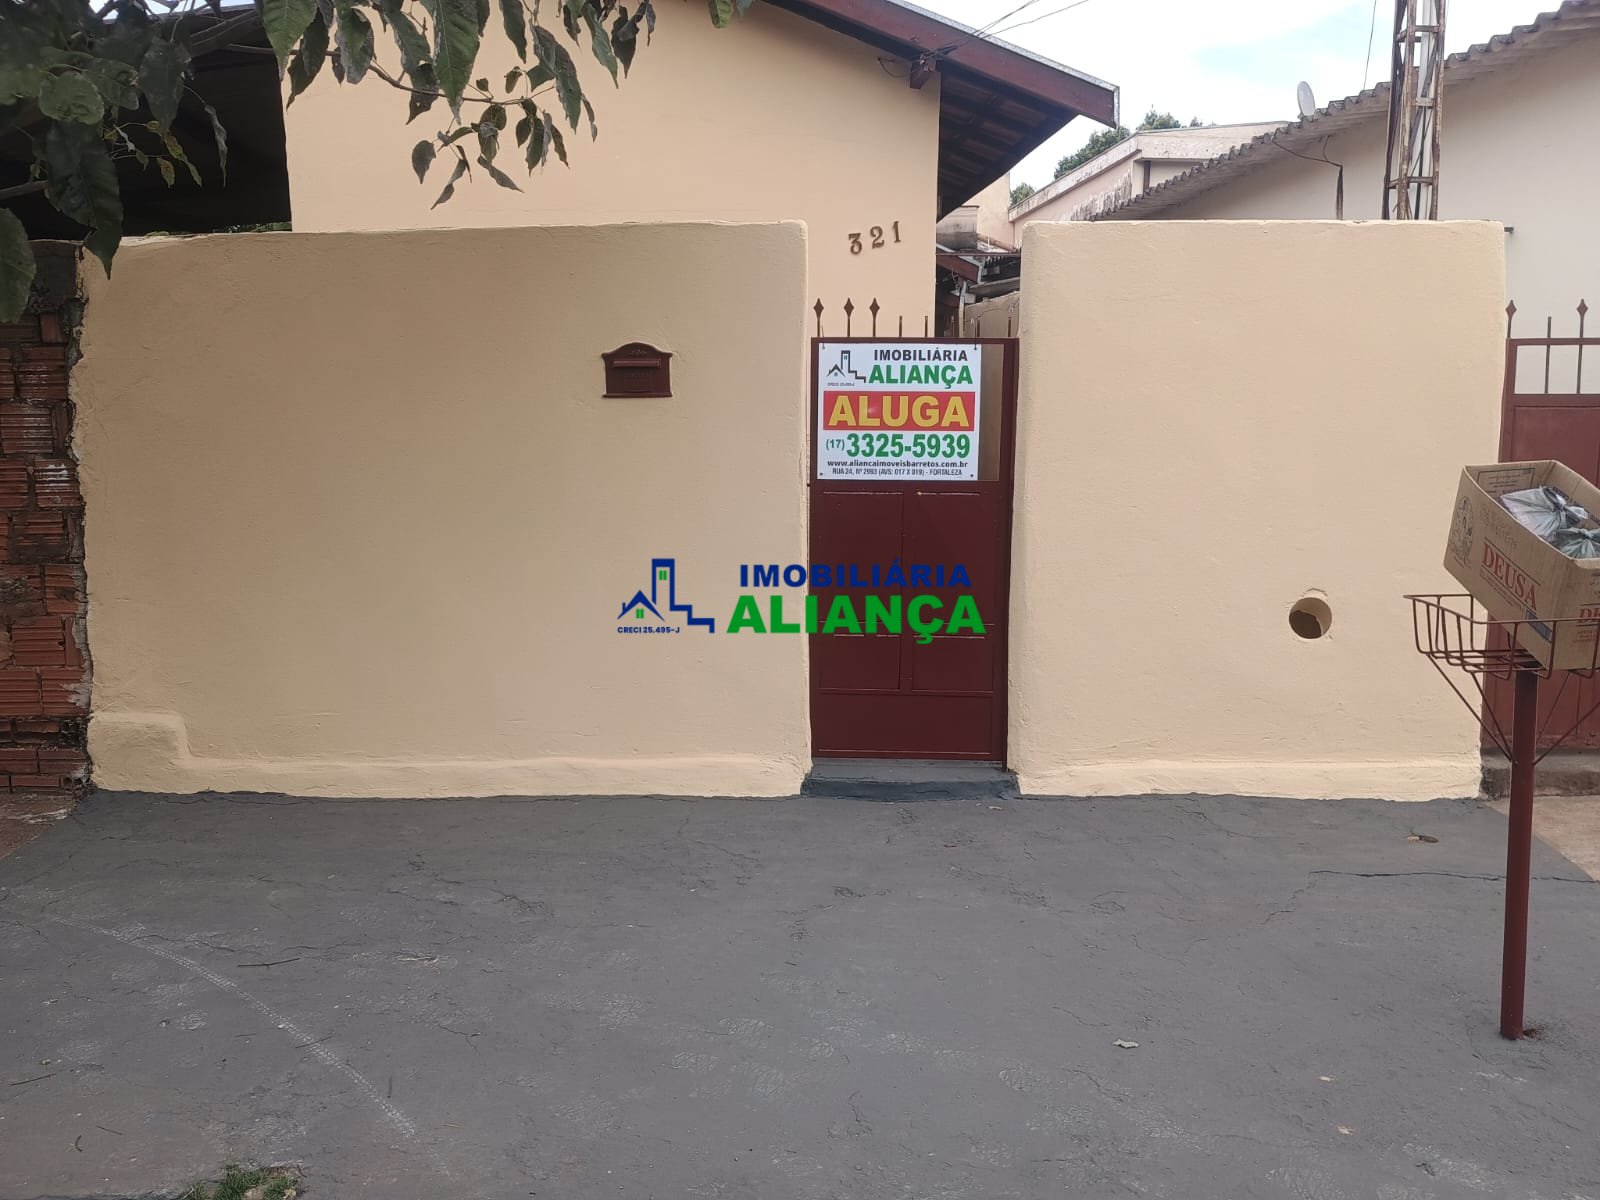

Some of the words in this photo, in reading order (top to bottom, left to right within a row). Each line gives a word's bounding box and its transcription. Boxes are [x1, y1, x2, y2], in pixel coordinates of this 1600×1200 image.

[848, 220, 901, 255] 321
[874, 347, 968, 361] IMOBILIÁRIA
[869, 364, 973, 389] ALIANÇA
[828, 395, 970, 427] ALUGA
[825, 438, 845, 451] (17)
[846, 433, 970, 458] 3325-5939
[827, 459, 968, 468] www.aliancaimoveisbarretos.com.br
[1483, 542, 1537, 611] DEUSA
